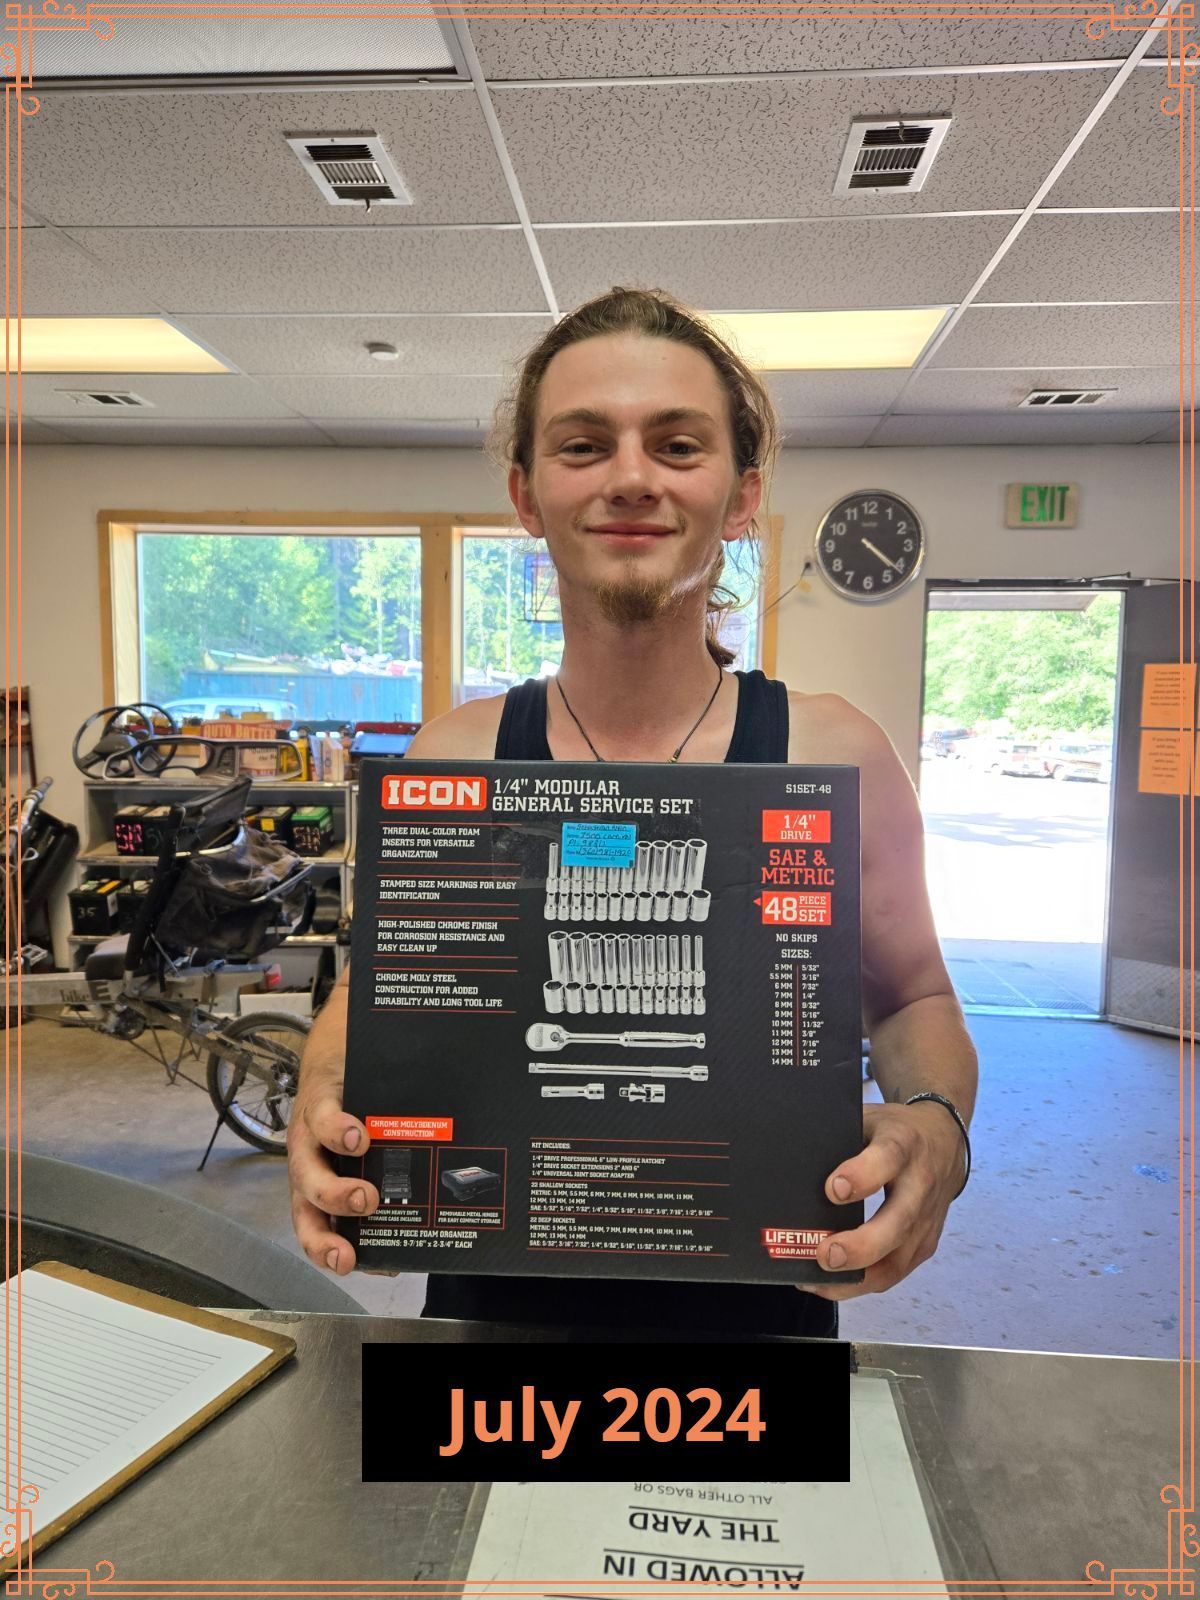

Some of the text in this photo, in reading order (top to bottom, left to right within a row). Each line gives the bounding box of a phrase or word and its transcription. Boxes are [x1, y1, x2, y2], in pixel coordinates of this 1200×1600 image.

[862, 501, 878, 514] 12
[1021, 486, 1069, 522] EXIT
[845, 508, 857, 520] 11
[886, 507, 893, 520] 1
[830, 523, 846, 535] 10
[896, 521, 907, 535] 2
[825, 540, 835, 553] 9
[904, 539, 913, 552] 3
[832, 559, 842, 572] 8
[895, 558, 904, 570] 4
[845, 571, 854, 584] 7
[863, 576, 873, 589] 6
[882, 570, 892, 583] 5
[388, 780, 480, 805] ICON
[494, 778, 620, 795] 1/4" MODULAR
[785, 783, 831, 793] S1SET-48
[492, 796, 693, 814] GENERAL SERVICE SET
[784, 814, 815, 828] 1/4"
[382, 826, 480, 835] THREE DUAL-COLOR FOAM
[780, 830, 811, 840] DRIVE
[381, 838, 475, 847] INSERTS FOR VERSATILE
[381, 849, 438, 858] ORGANIZATION
[769, 848, 827, 866] SAE &
[761, 867, 834, 885] METRIC
[380, 879, 516, 889] STAMPED SIZE MARKINGS FOR EASY
[379, 891, 440, 899] IDENTIFICATION
[799, 895, 826, 907] PIECE
[764, 897, 797, 921] 48
[798, 909, 826, 922] SET
[378, 920, 497, 929] HIGH-POLISHED CHROME FINISH
[377, 931, 505, 941] FOR CORROSION RESISTANCE AND
[775, 933, 817, 942] NO SKIPS
[377, 943, 397, 951] EASY
[426, 944, 437, 952] UP
[781, 948, 811, 958] SIZES:
[375, 973, 457, 982] CHROME MOLY STEEL
[375, 985, 478, 994] CONSTRUCTION FOR ADDED
[374, 997, 502, 1007] DURABILITY AND LONG TOOL LIFE
[383, 1128, 434, 1137] CONSTRUCTION
[359, 1228, 392, 1236] INCLUDED
[399, 1229, 418, 1237] PIECE
[439, 1230, 477, 1238] ORGANIZER
[765, 1230, 828, 1244] LIFETIME
[359, 1238, 401, 1246] DIMENSIONS:
[403, 1239, 426, 1247] 9-7/16"
[454, 1240, 472, 1248] EACH
[634, 1482, 773, 1505] ALL OTHER BAGS OR
[629, 1512, 780, 1543] THE YARD
[603, 1555, 804, 1590] ALLOWED IN
